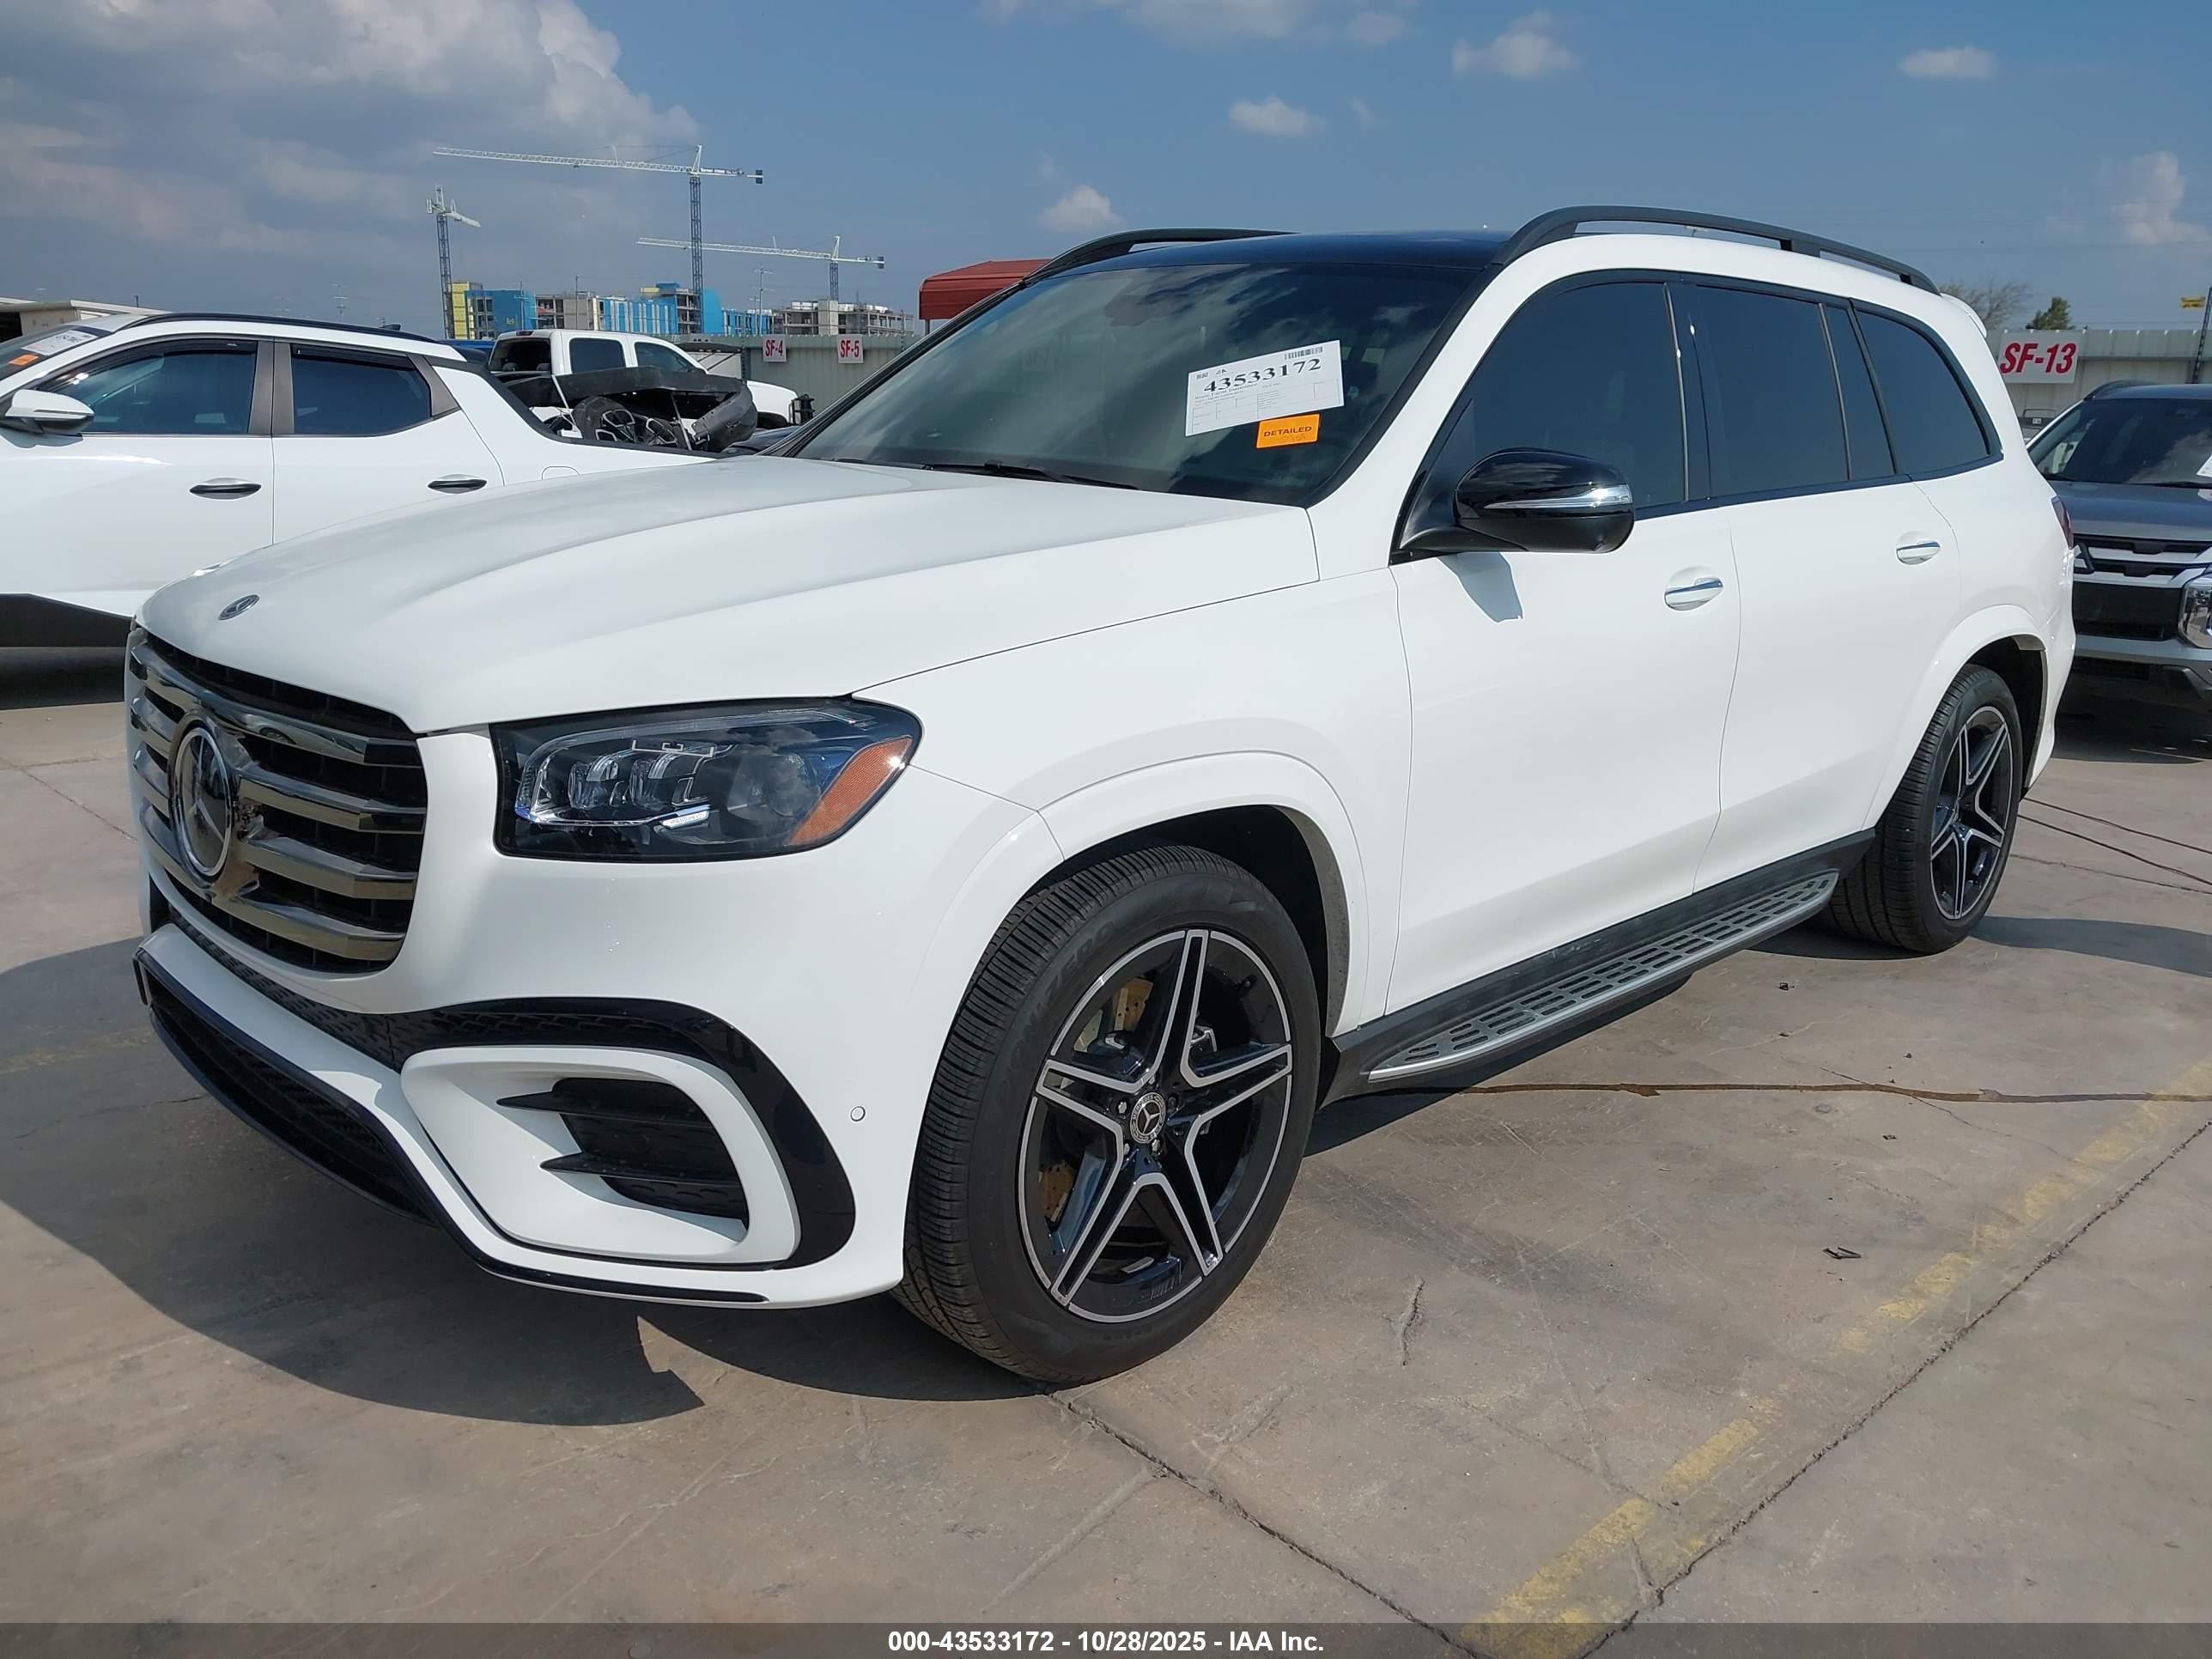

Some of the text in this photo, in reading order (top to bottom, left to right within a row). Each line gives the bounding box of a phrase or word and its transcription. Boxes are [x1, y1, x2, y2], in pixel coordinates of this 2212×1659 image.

[765, 339, 783, 356] SF-4
[840, 339, 860, 358] SF-5
[1999, 343, 2077, 374] SF-13
[1203, 358, 1322, 392] 43533172
[1263, 426, 1312, 437] DETAILED
